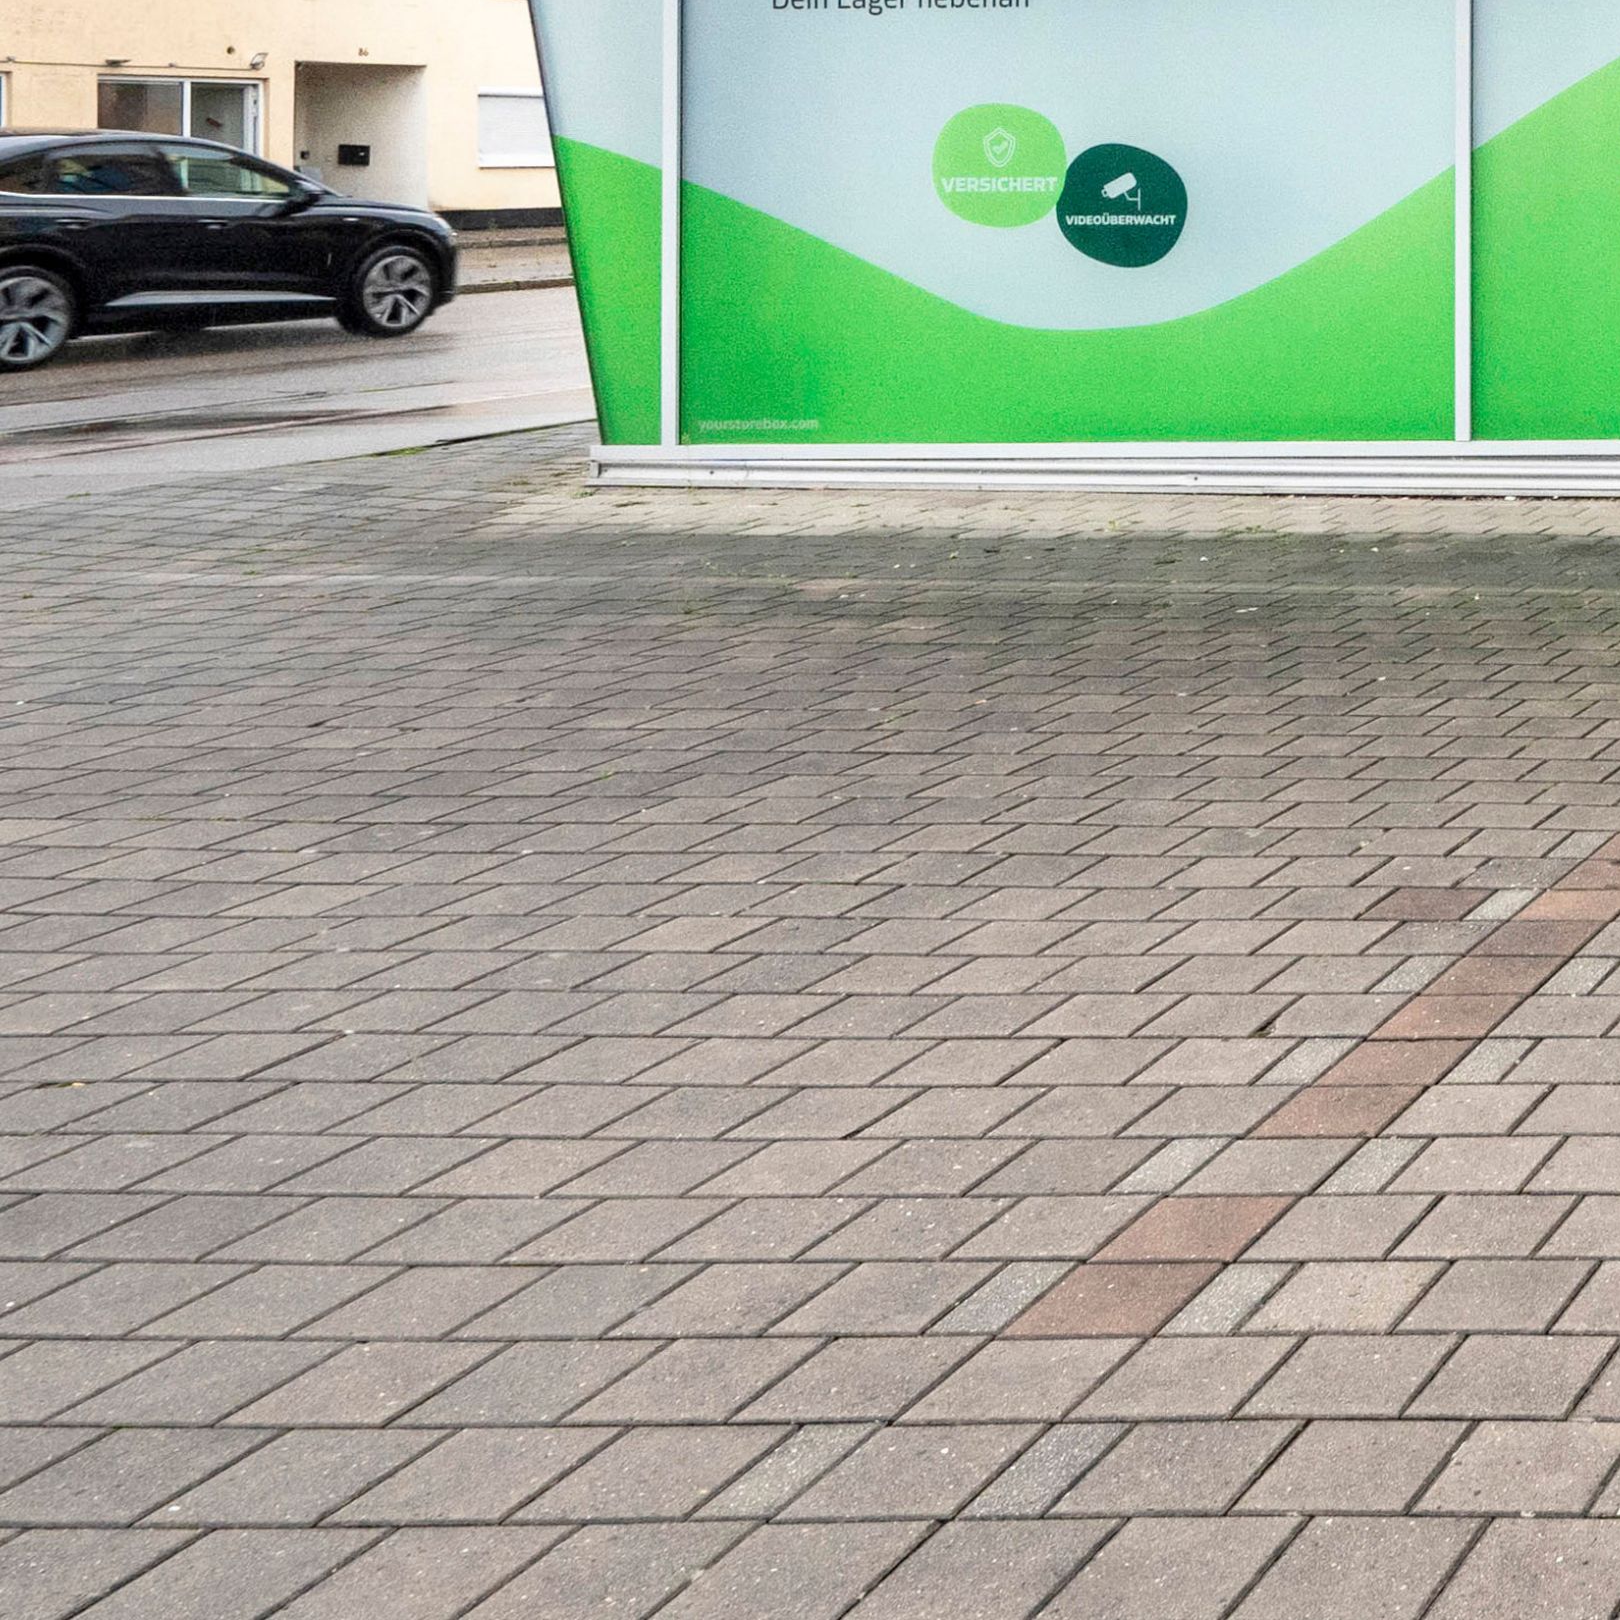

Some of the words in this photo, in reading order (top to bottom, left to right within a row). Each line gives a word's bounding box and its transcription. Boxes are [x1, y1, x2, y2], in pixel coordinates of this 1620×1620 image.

[942, 176, 1058, 193] VERSICHERT
[1066, 213, 1177, 225] VIDEOÜBERWACHT
[699, 417, 819, 433] yourstorebox.com
